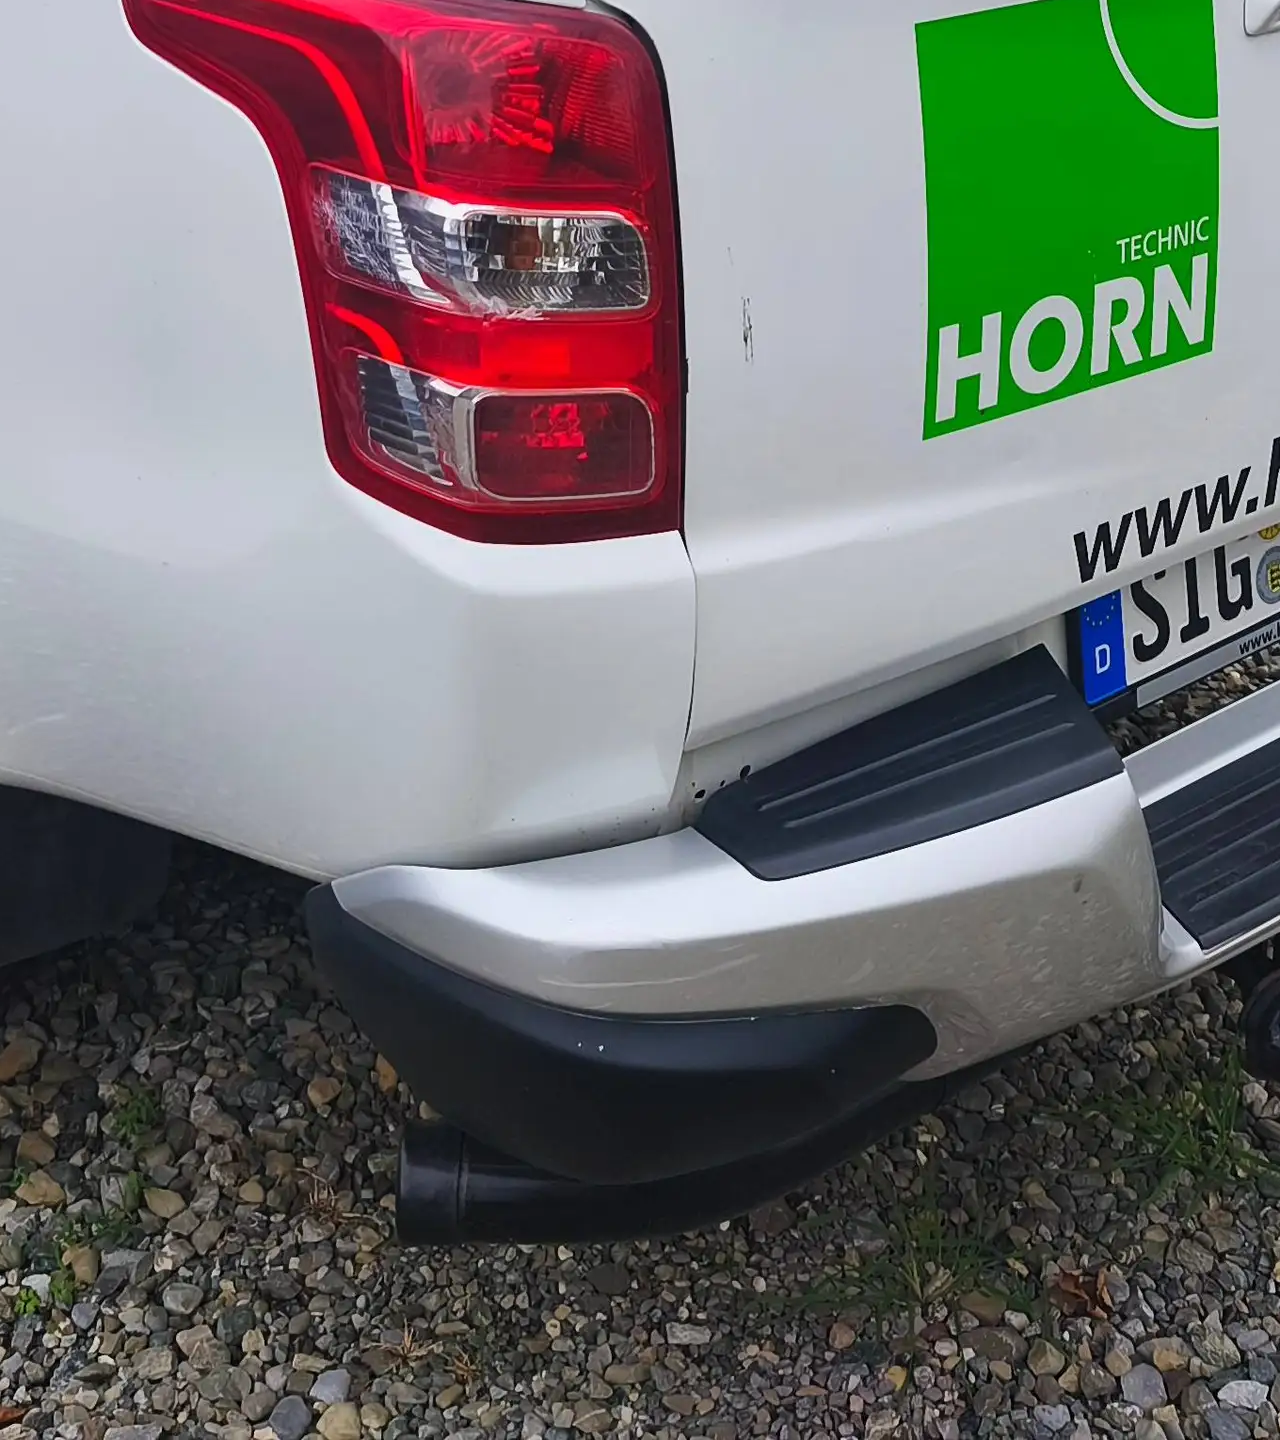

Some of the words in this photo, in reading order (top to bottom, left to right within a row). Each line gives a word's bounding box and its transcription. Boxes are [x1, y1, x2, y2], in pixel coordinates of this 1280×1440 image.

[1116, 216, 1210, 264] TECHNIC
[935, 252, 1209, 424] HORN
[1130, 536, 1254, 663] SIG
[1094, 643, 1111, 675] D
